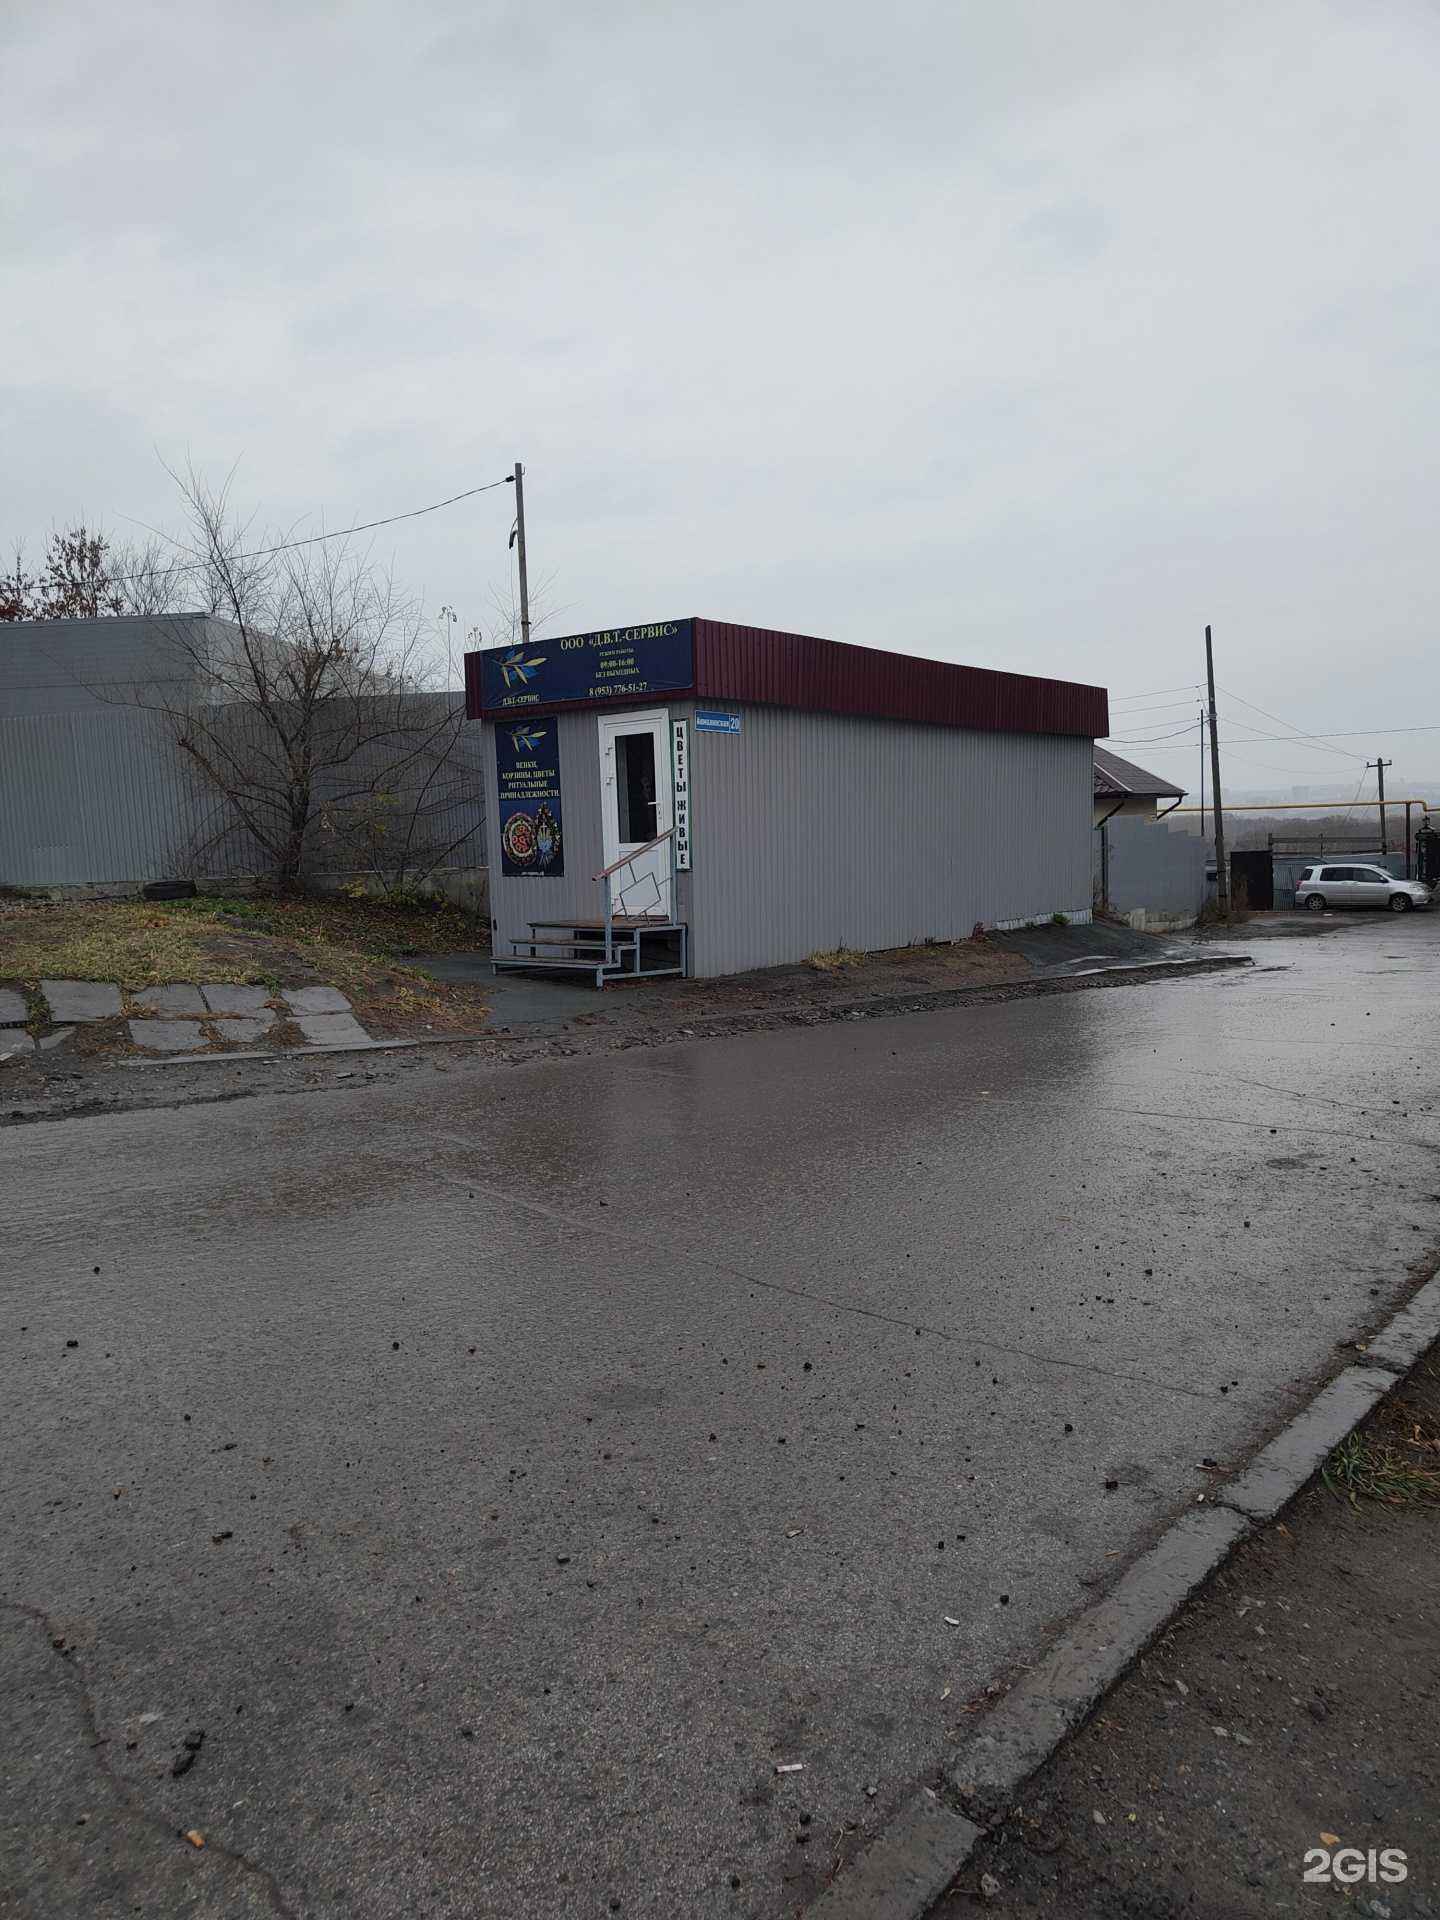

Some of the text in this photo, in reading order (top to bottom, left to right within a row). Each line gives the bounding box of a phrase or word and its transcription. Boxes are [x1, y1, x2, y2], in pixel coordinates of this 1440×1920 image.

[560, 637, 584, 651] ООО
[588, 687, 594, 697] 8
[594, 685, 612, 697] (953)
[676, 726, 688, 865] ЦВЕТЫ ЖИВЫЕ
